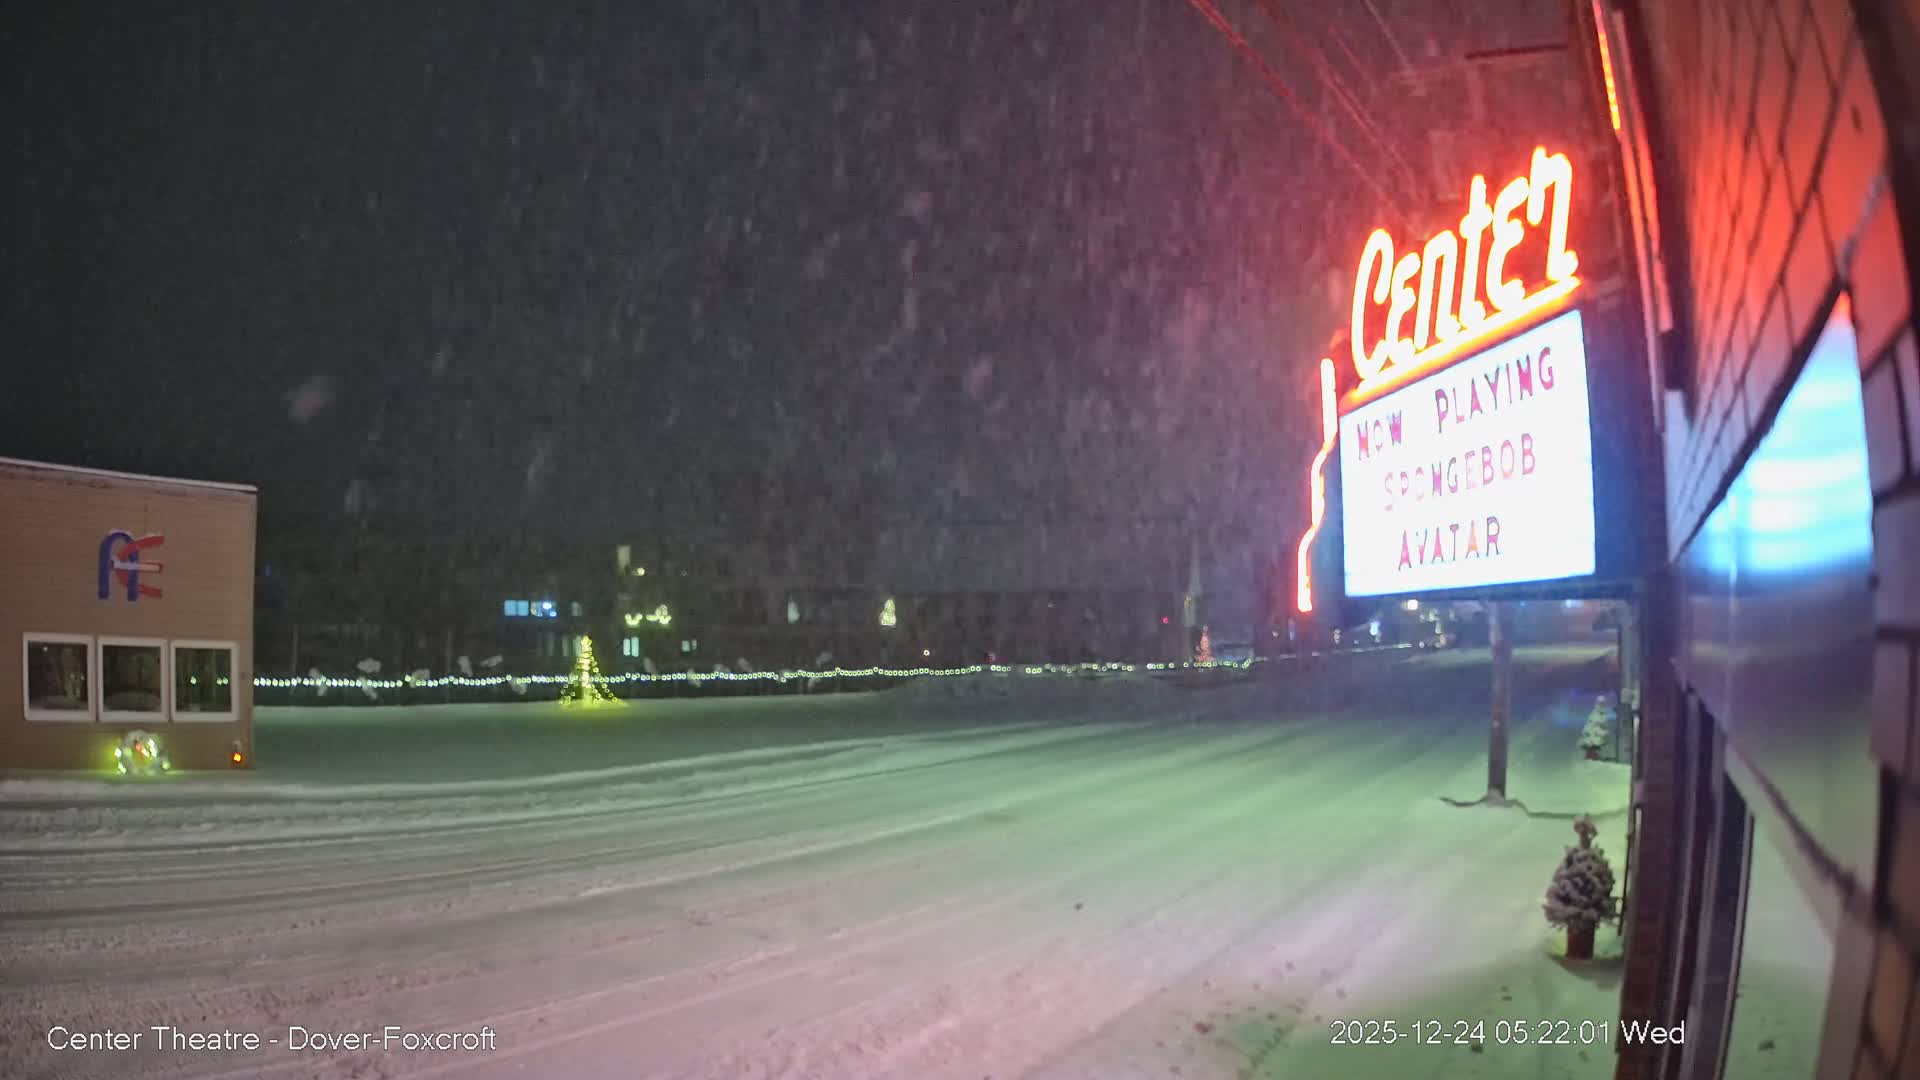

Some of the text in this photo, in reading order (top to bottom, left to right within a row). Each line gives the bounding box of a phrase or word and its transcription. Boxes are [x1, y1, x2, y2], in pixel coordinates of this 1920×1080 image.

[1356, 346, 1555, 461] NOW PLAYING
[1384, 432, 1537, 511] SPONGEBOB
[1398, 515, 1502, 572] AVATAR
